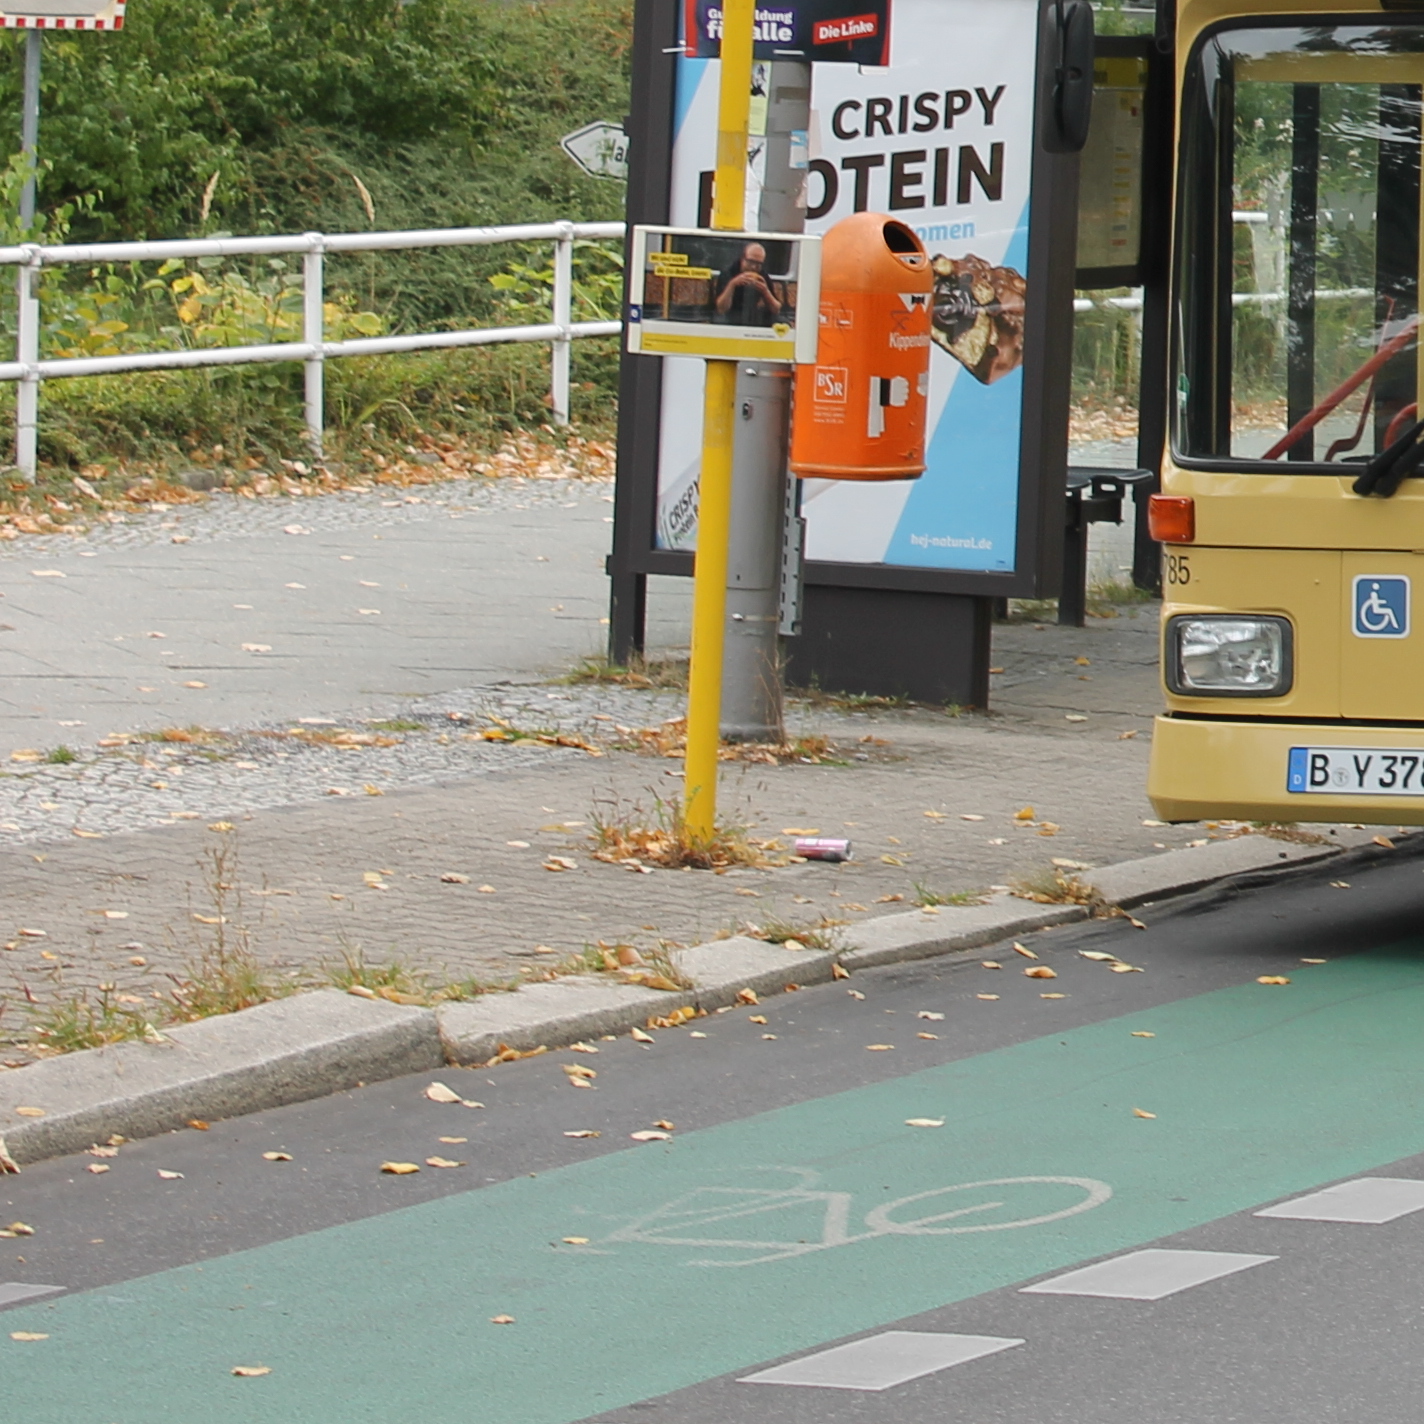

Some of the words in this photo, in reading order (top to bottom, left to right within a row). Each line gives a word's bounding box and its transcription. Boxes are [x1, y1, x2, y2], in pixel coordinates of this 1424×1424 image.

[818, 25, 840, 40] Die
[841, 20, 875, 37] Linke
[831, 84, 1007, 141] CRISPY
[817, 372, 843, 398] BSR
[910, 533, 993, 552] hej-natural.de
[1310, 753, 1330, 787] B
